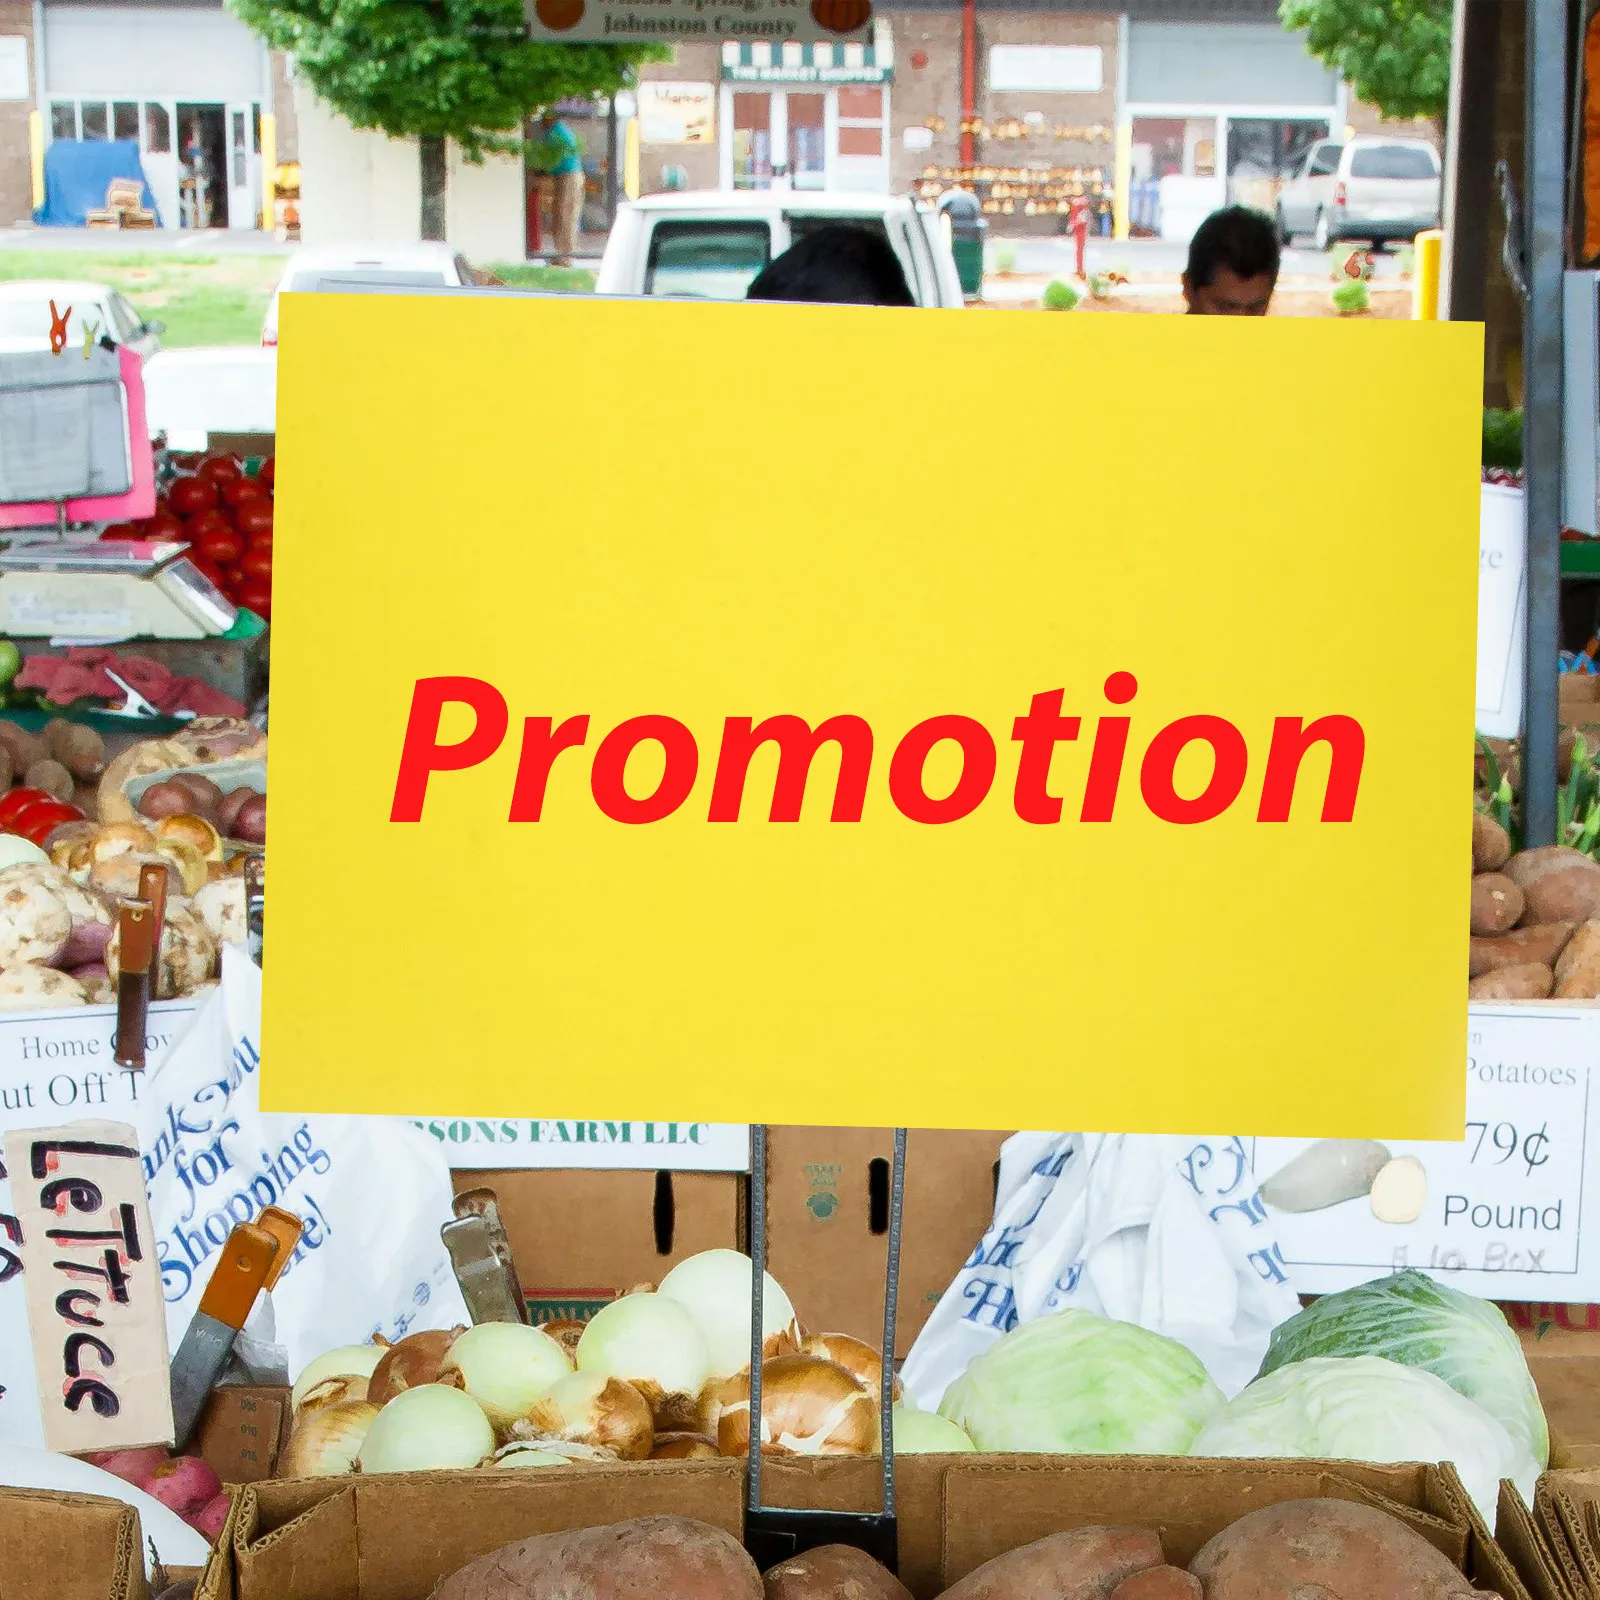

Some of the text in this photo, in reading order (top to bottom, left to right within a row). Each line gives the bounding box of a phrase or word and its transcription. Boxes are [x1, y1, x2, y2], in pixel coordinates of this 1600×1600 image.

[713, 14, 797, 37] County
[389, 671, 1366, 824] Promotion
[22, 1036, 100, 1059] Home
[48, 1072, 111, 1107] Off
[141, 1100, 213, 1184] ank
[527, 1120, 635, 1144] FARM
[643, 1121, 711, 1145] LLC
[173, 1119, 240, 1223] for
[1444, 1194, 1562, 1230] Pound
